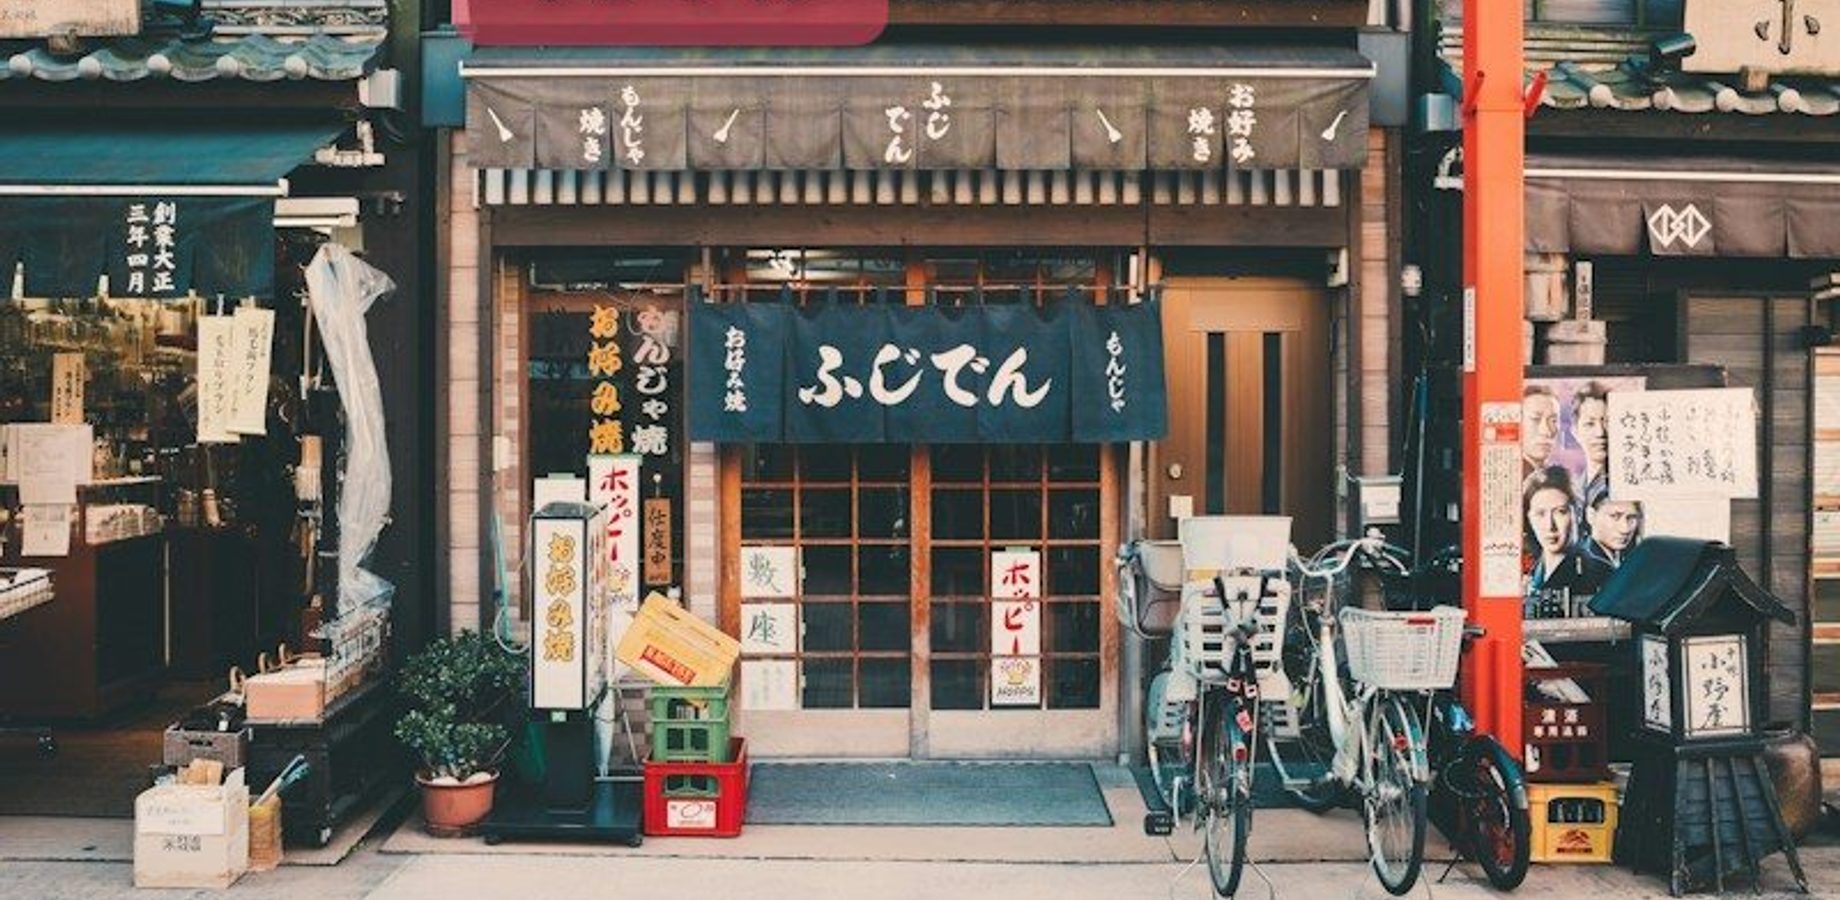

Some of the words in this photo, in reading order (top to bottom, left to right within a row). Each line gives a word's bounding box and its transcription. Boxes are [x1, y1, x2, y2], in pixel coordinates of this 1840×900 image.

[579, 107, 606, 162] 焼き
[620, 84, 645, 165] もんじゃ
[884, 105, 912, 163] でん
[922, 81, 952, 140] ふじ
[1188, 107, 1215, 162] 焼き
[1227, 83, 1257, 162] お好み
[127, 204, 150, 294] 三年四月
[152, 201, 176, 292] 創業大正
[588, 304, 624, 454] お好み焼
[631, 305, 671, 455] もんじゃ焼
[724, 325, 747, 412] お好み焼
[798, 343, 1052, 408] ふじでん
[1105, 331, 1126, 412] もんじゃ
[649, 508, 668, 566] 仕度中
[543, 530, 577, 663] お好み焼
[1002, 560, 1035, 655] ホッピー
